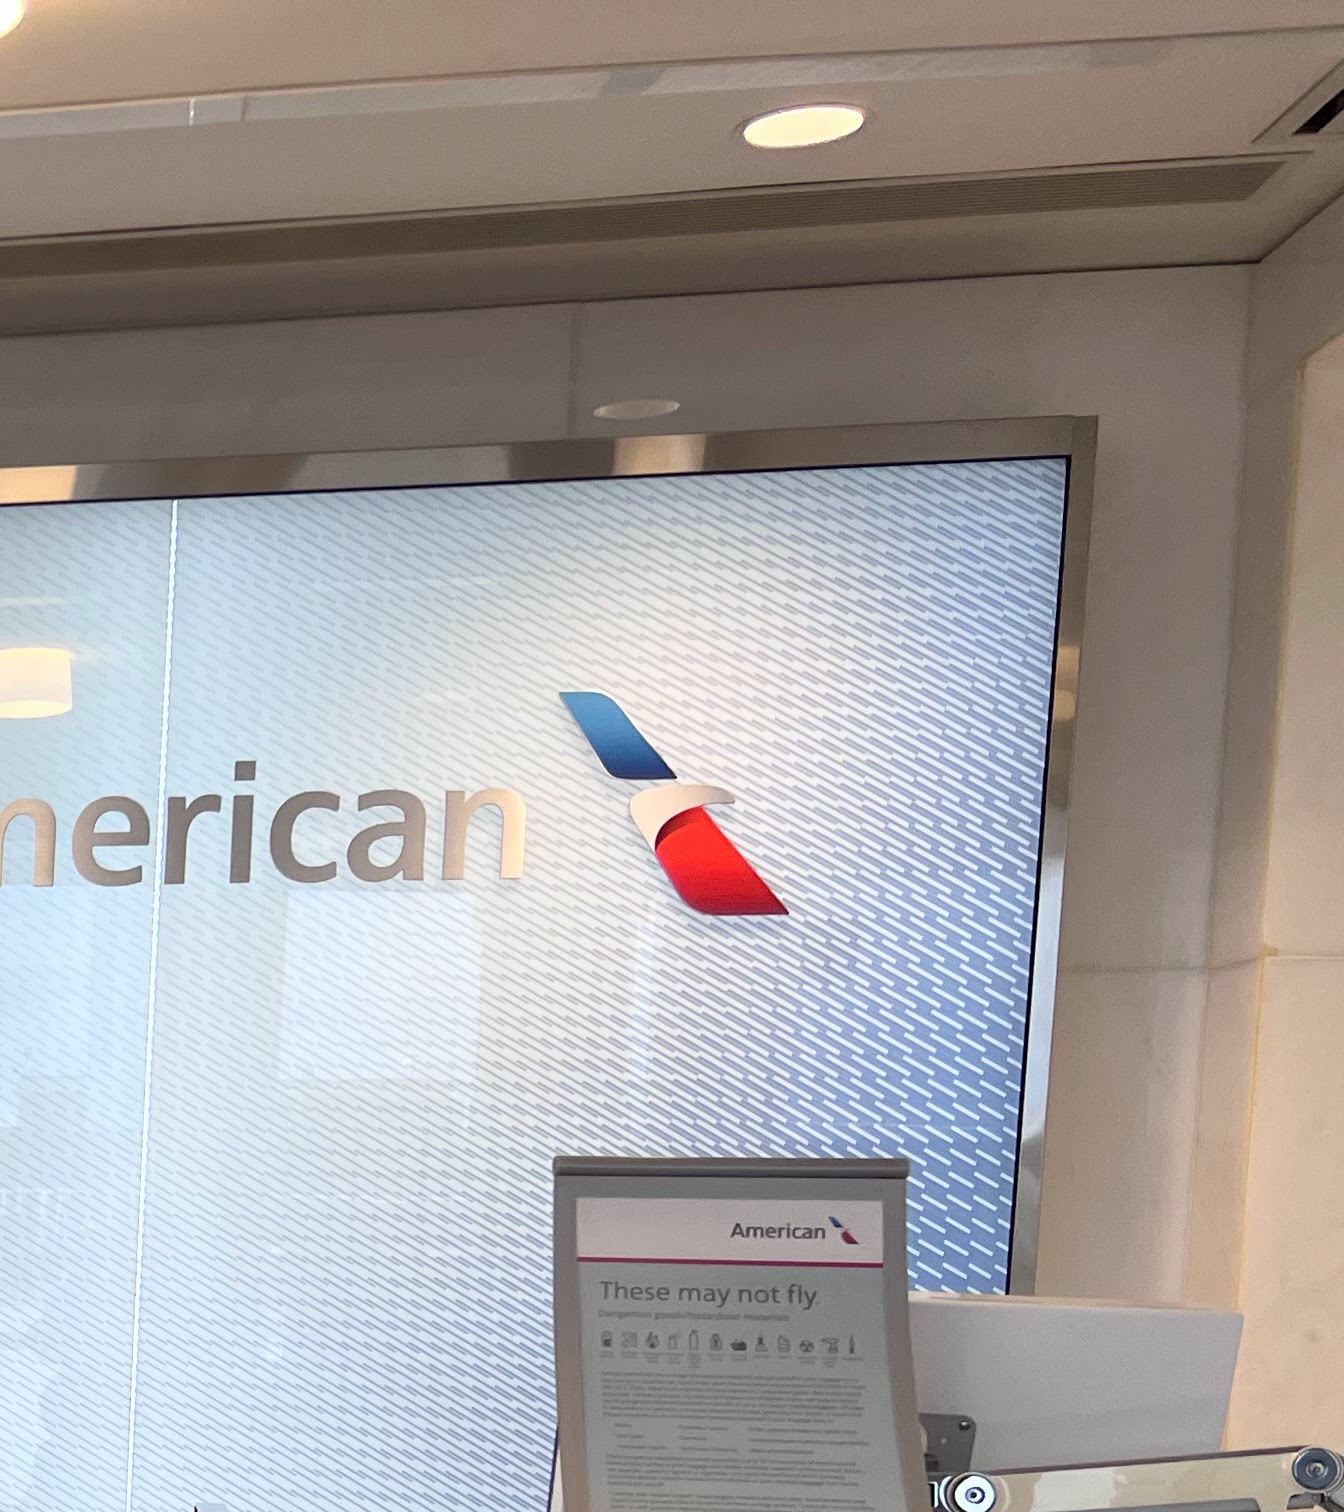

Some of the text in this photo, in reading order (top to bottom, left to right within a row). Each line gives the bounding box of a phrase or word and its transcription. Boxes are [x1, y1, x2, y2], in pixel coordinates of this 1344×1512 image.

[730, 1222, 826, 1240] American
[599, 1280, 670, 1301] These
[678, 1286, 731, 1309] may
[738, 1284, 781, 1305] not
